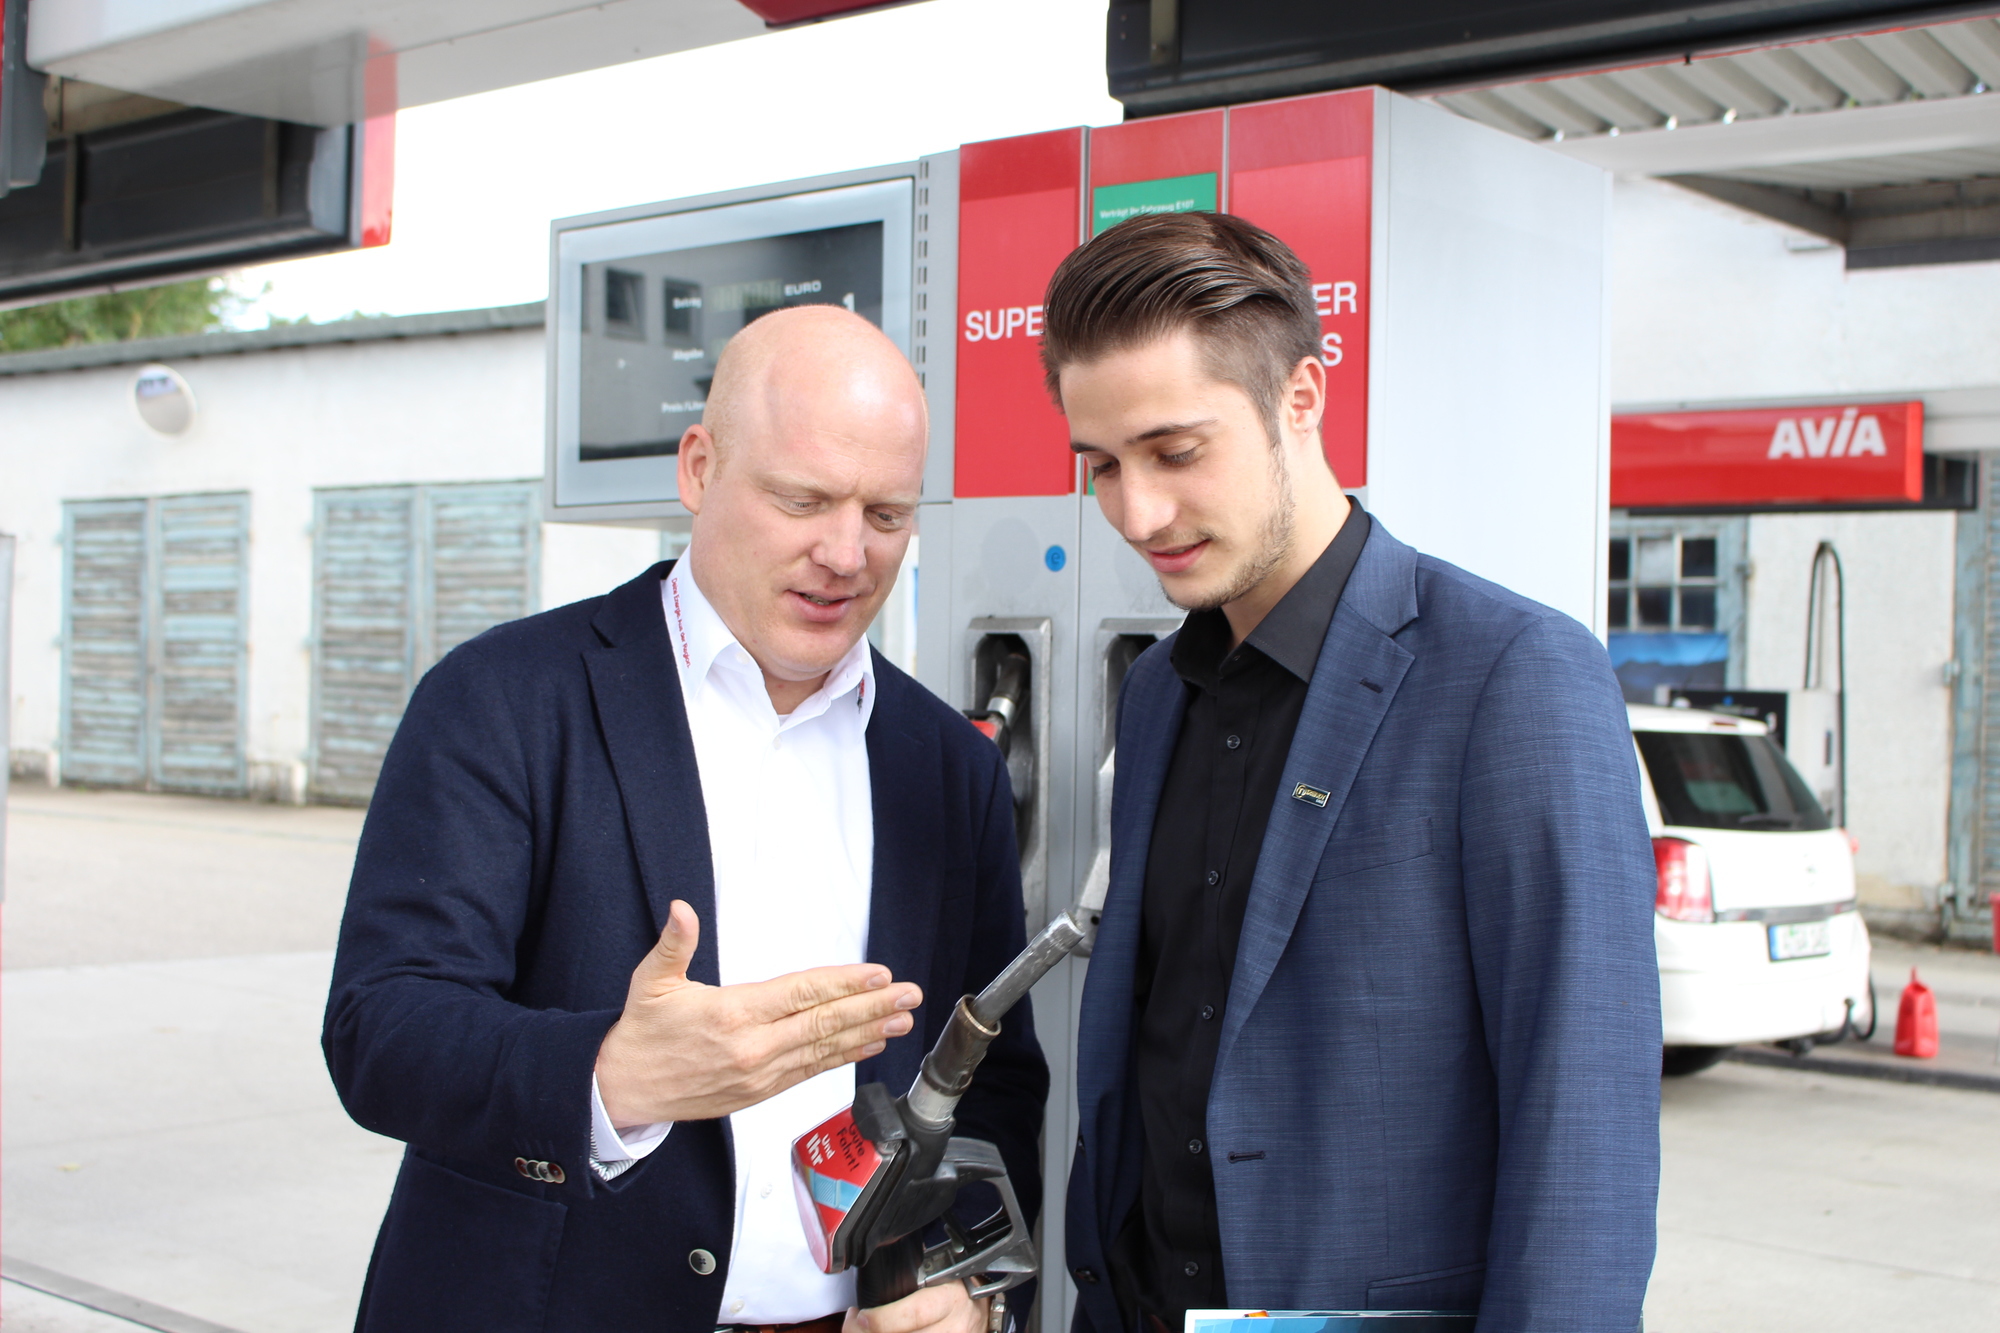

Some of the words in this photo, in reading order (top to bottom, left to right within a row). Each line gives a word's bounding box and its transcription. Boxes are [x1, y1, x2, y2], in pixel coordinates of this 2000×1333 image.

[785, 280, 822, 295] EURO
[964, 304, 1045, 342] SUPE
[806, 1132, 824, 1166] Ihr
[821, 1133, 836, 1160] Und
